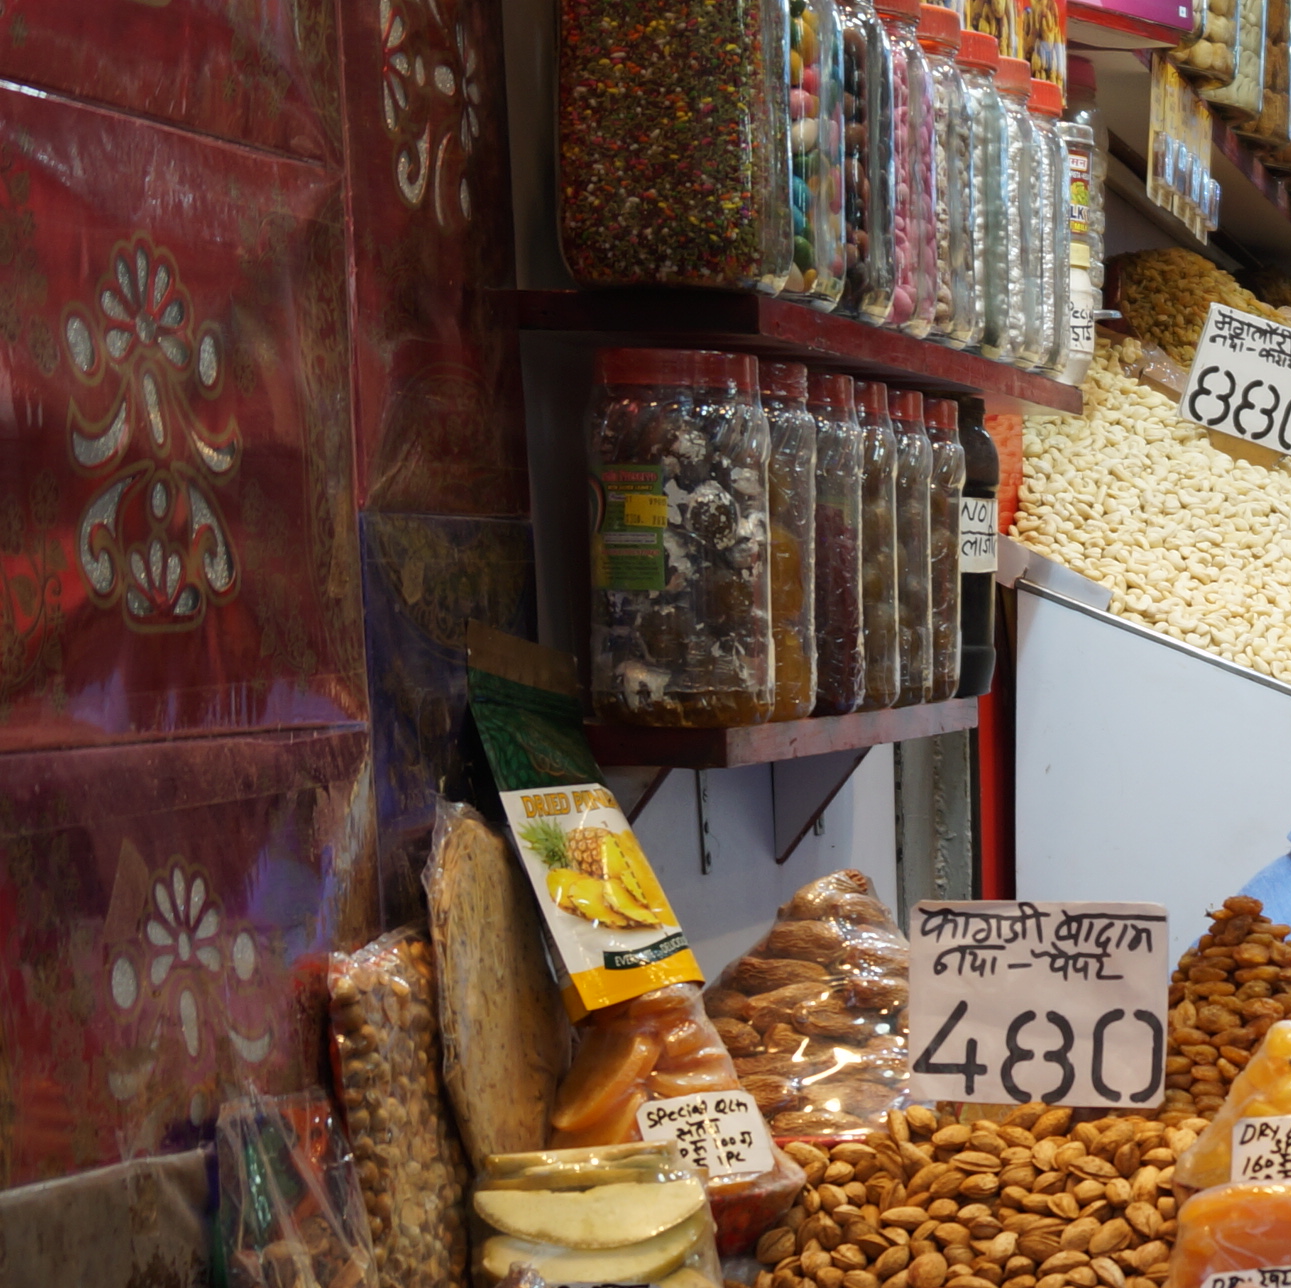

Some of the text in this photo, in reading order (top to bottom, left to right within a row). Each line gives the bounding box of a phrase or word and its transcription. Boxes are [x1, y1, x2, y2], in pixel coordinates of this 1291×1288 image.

[520, 791, 571, 818] DRIED
[1054, 910, 1166, 952] बादाम
[934, 944, 1005, 977] नया
[912, 1000, 1164, 1104] 480
